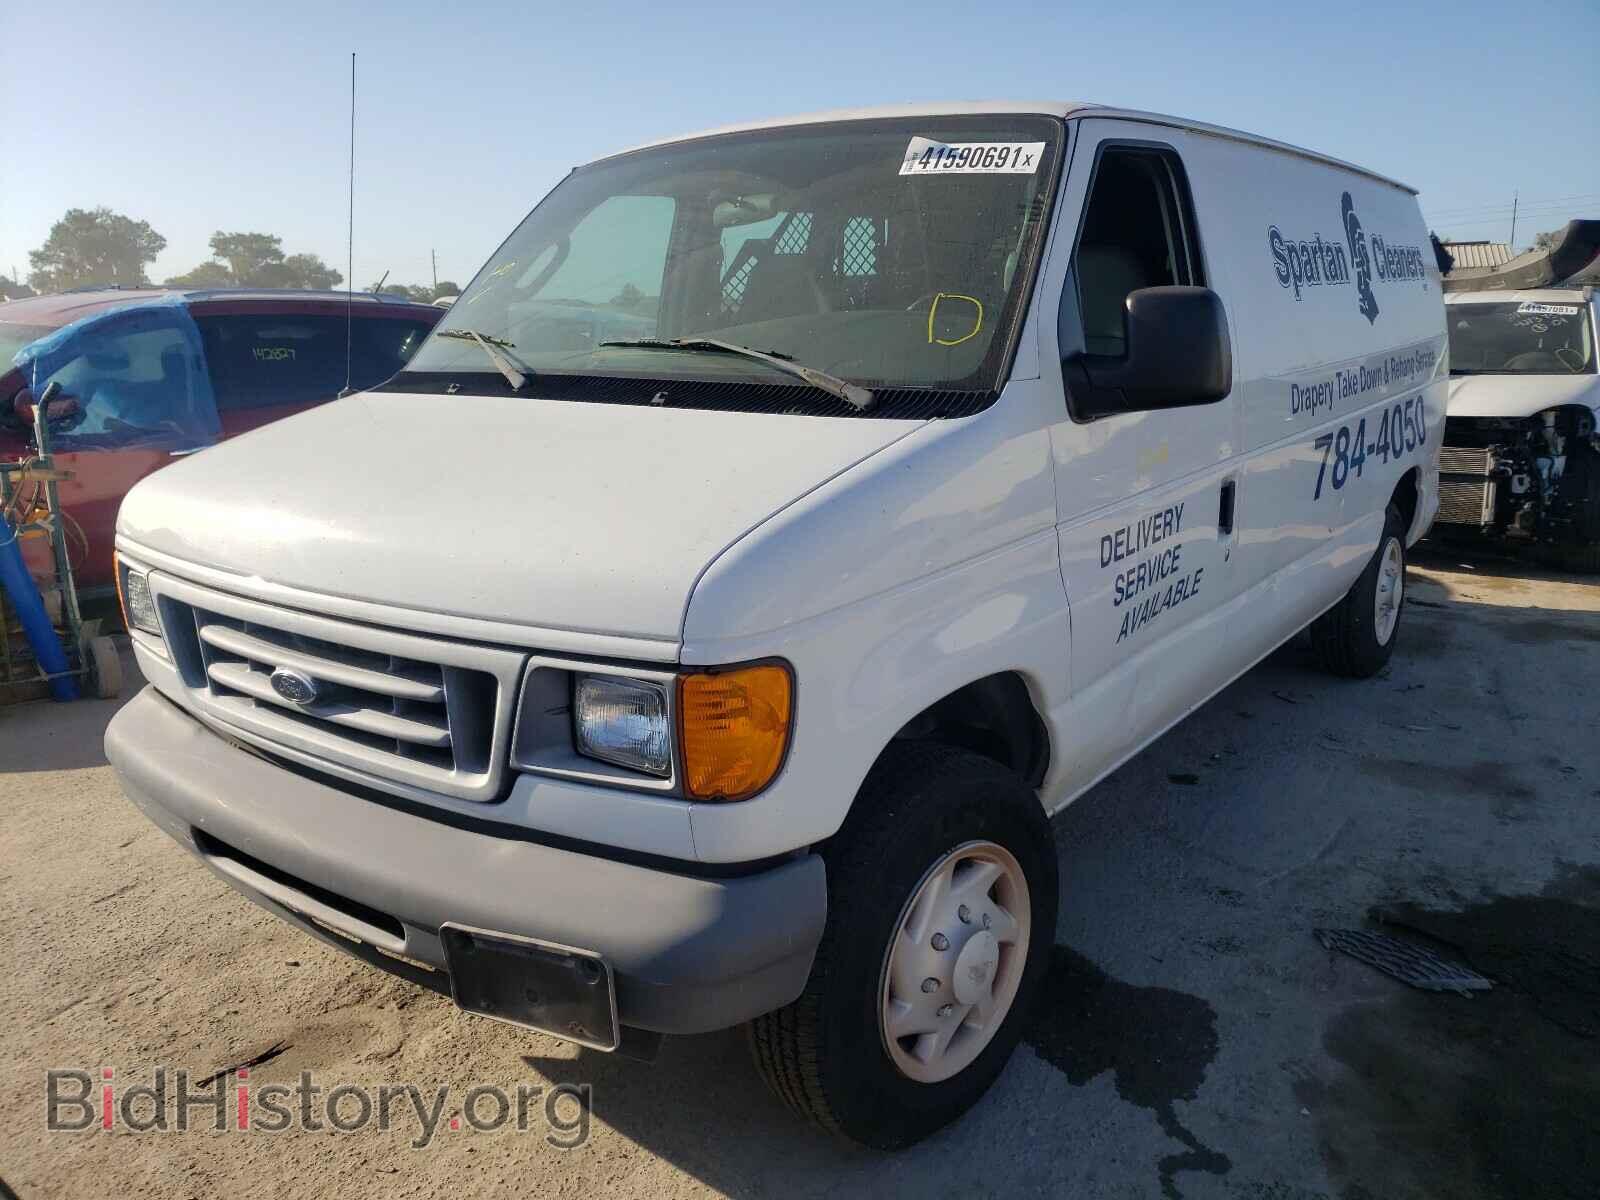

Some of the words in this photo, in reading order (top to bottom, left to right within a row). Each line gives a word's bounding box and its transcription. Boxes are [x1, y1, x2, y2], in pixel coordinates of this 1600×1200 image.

[918, 146, 1023, 170] 41590691
[1267, 224, 1350, 303] Spartan
[1370, 233, 1425, 282] Cleaners
[1291, 381, 1334, 416] Drapery
[1336, 371, 1358, 400] Take
[1359, 365, 1382, 393] Down
[1314, 394, 1426, 501] 784-4050
[1100, 502, 1184, 568] DELIVERY
[1114, 544, 1182, 606] SERVICE
[1116, 568, 1204, 644] AVAILABLE
